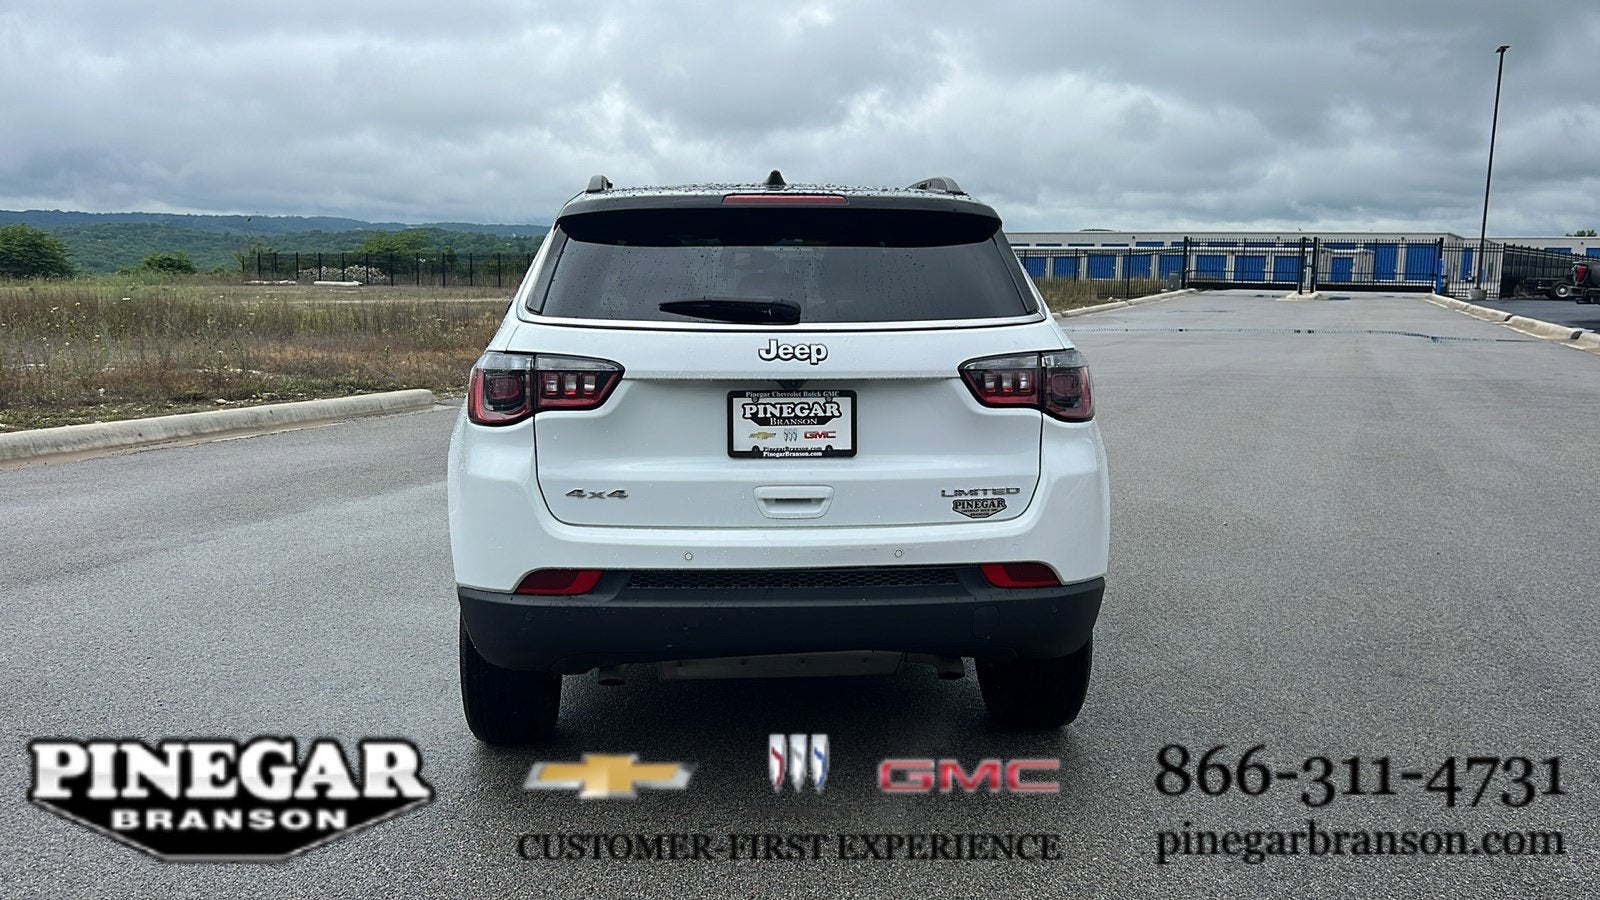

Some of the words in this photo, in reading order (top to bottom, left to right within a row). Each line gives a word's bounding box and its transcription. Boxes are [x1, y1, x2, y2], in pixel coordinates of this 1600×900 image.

[758, 339, 828, 365] Jeep
[744, 404, 841, 418] PINEGAR
[804, 431, 836, 439] GMC
[565, 489, 629, 499] 4x4
[941, 488, 1020, 497] LIMITED
[955, 500, 1005, 509] PINEGAR
